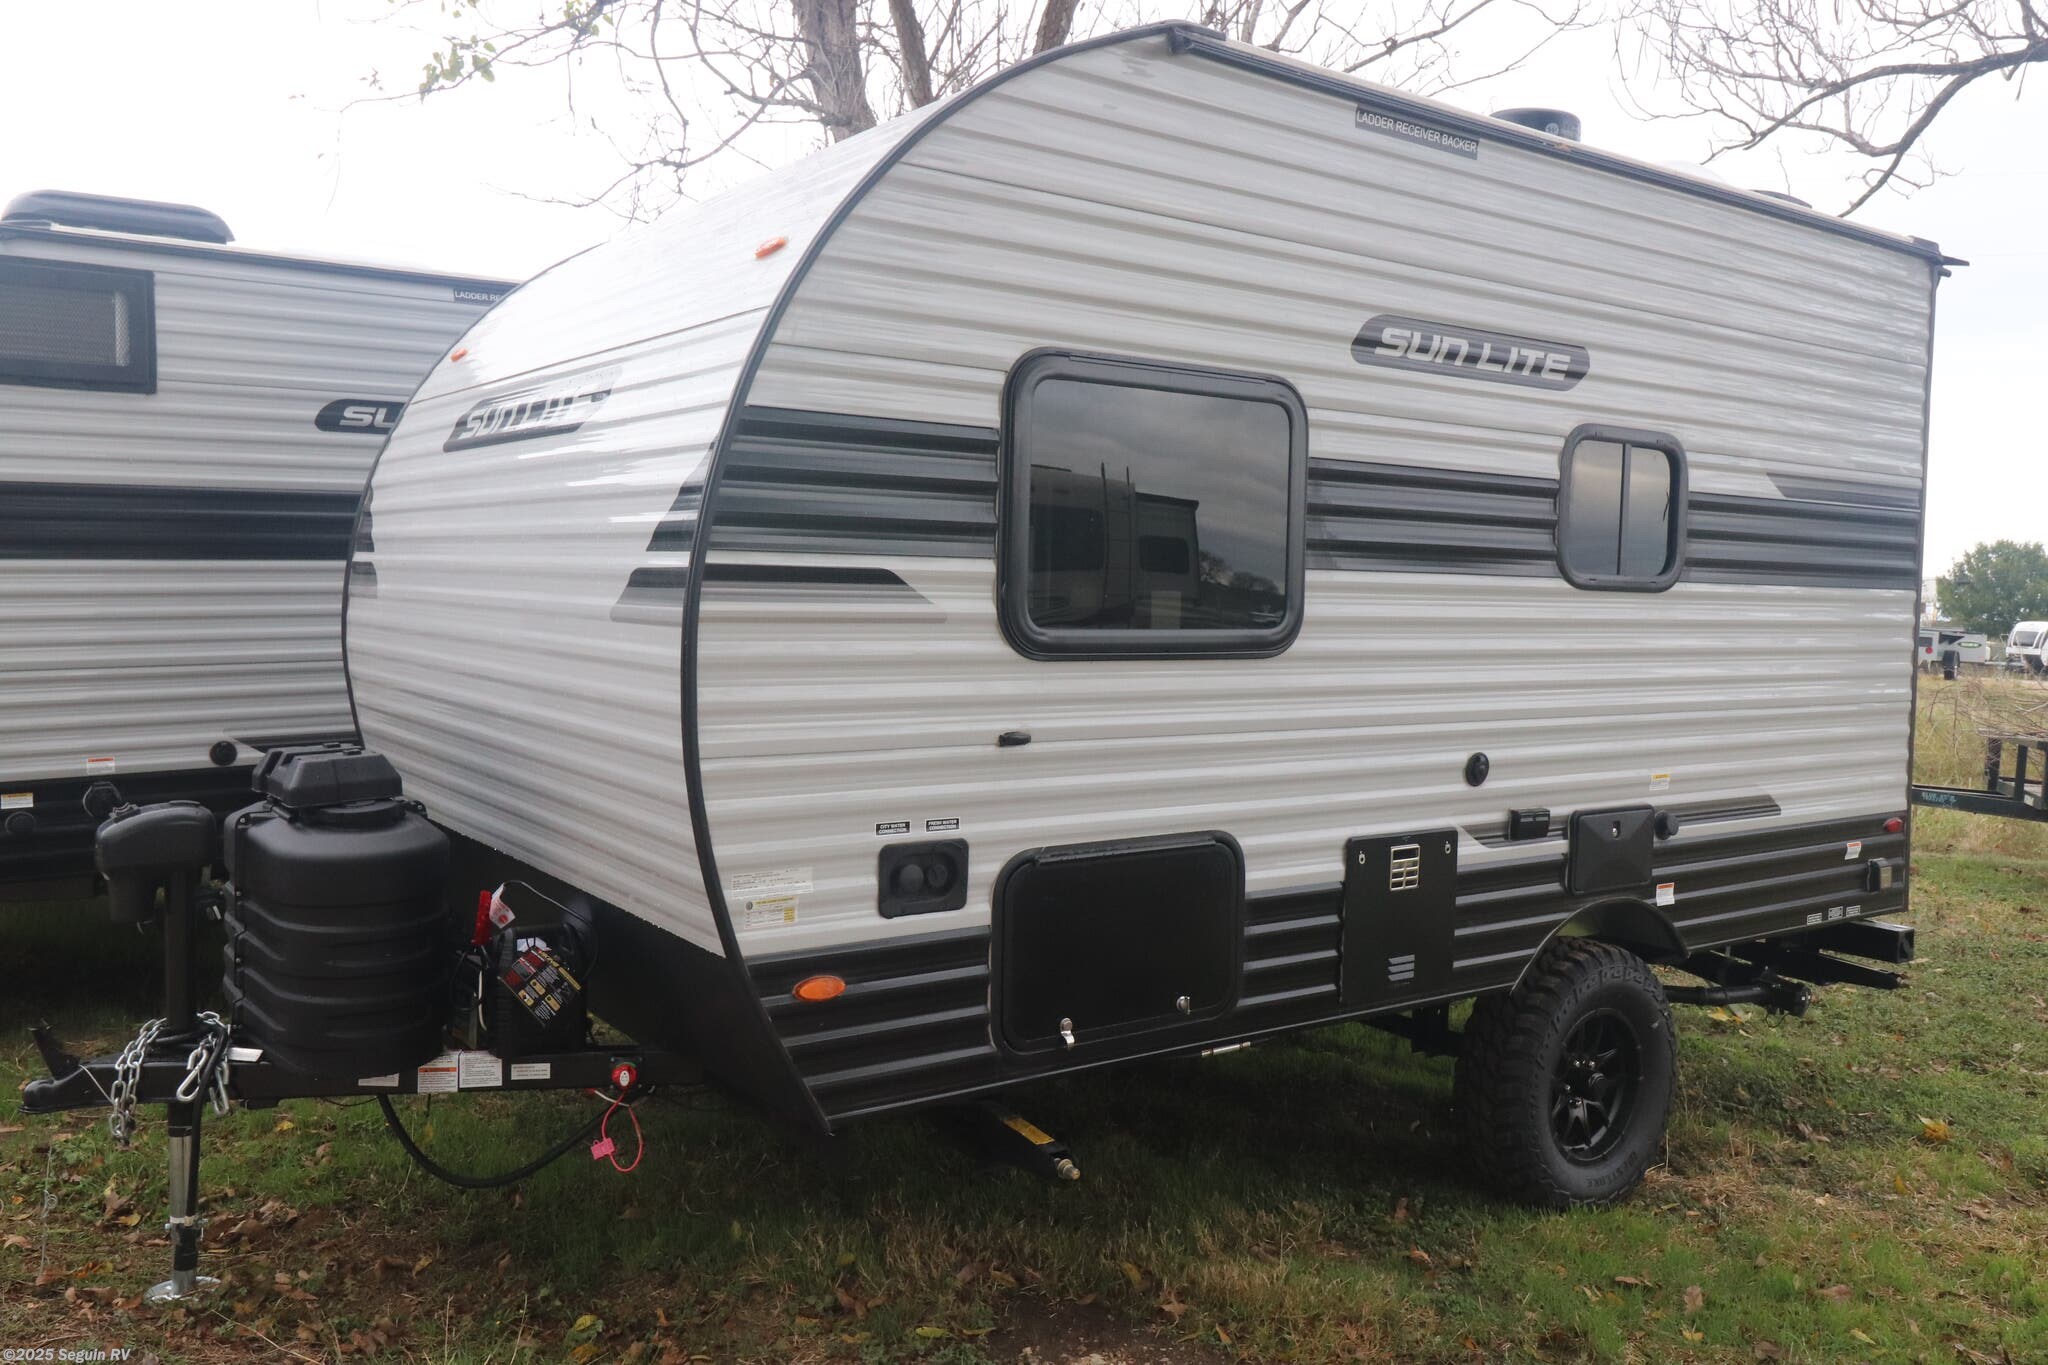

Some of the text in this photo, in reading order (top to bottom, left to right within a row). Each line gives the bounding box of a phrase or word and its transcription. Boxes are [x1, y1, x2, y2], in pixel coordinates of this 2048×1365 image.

[1356, 110, 1477, 153] LADDER RECEIVER BACKER
[454, 290, 489, 301] LADDER
[1476, 342, 1571, 381] LITE
